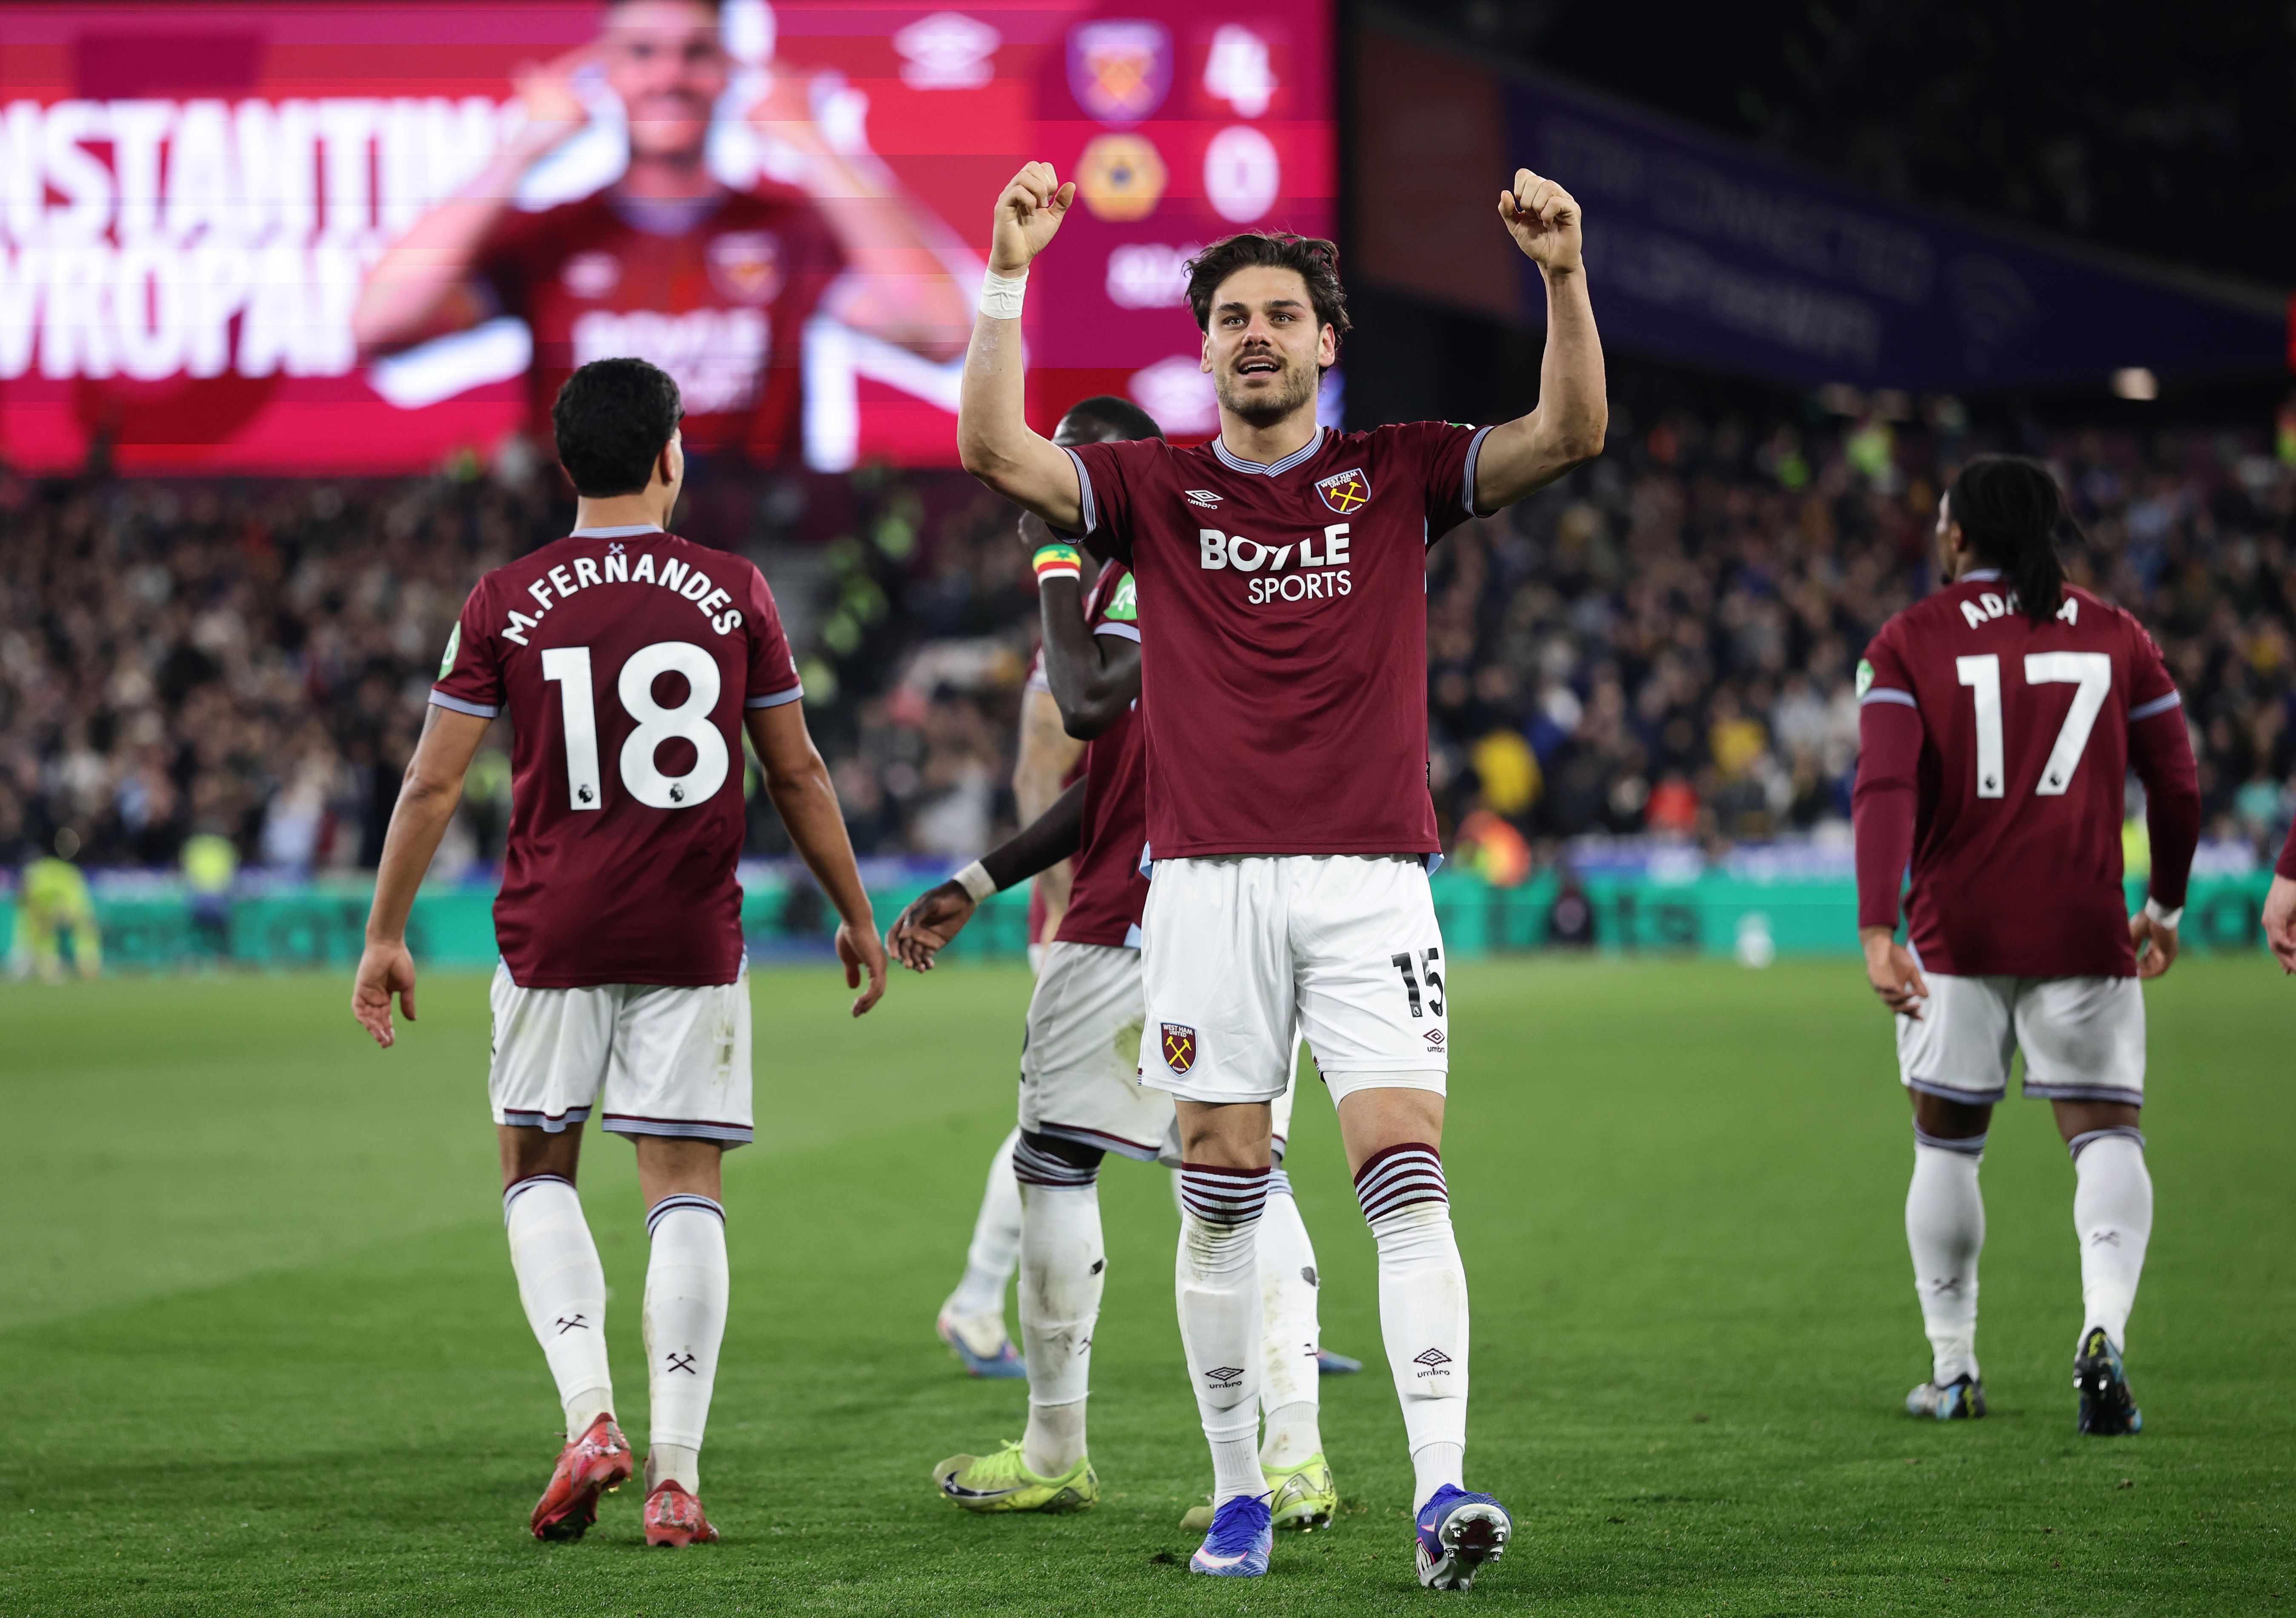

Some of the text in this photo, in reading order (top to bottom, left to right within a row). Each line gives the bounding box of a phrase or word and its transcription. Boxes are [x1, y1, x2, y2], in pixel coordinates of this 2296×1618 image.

[1205, 23, 1275, 118] 4
[1320, 471, 1358, 488] WEST HAM
[1330, 478, 1351, 488] UNITED
[1188, 498, 1218, 510] umbro
[1346, 503, 1363, 512] LONDON
[1200, 523, 1350, 571] BOYLE
[501, 554, 742, 646] M.FERNANDES
[1248, 570, 1351, 604] SPORTS
[1959, 589, 2078, 630] ADAA
[541, 641, 729, 811] 18
[1955, 651, 2111, 799] 17
[1391, 947, 1443, 1018] 15
[1169, 1030, 1187, 1038] UNITED
[1179, 1026, 1193, 1036] HAM
[1417, 1367, 1450, 1377] umbro
